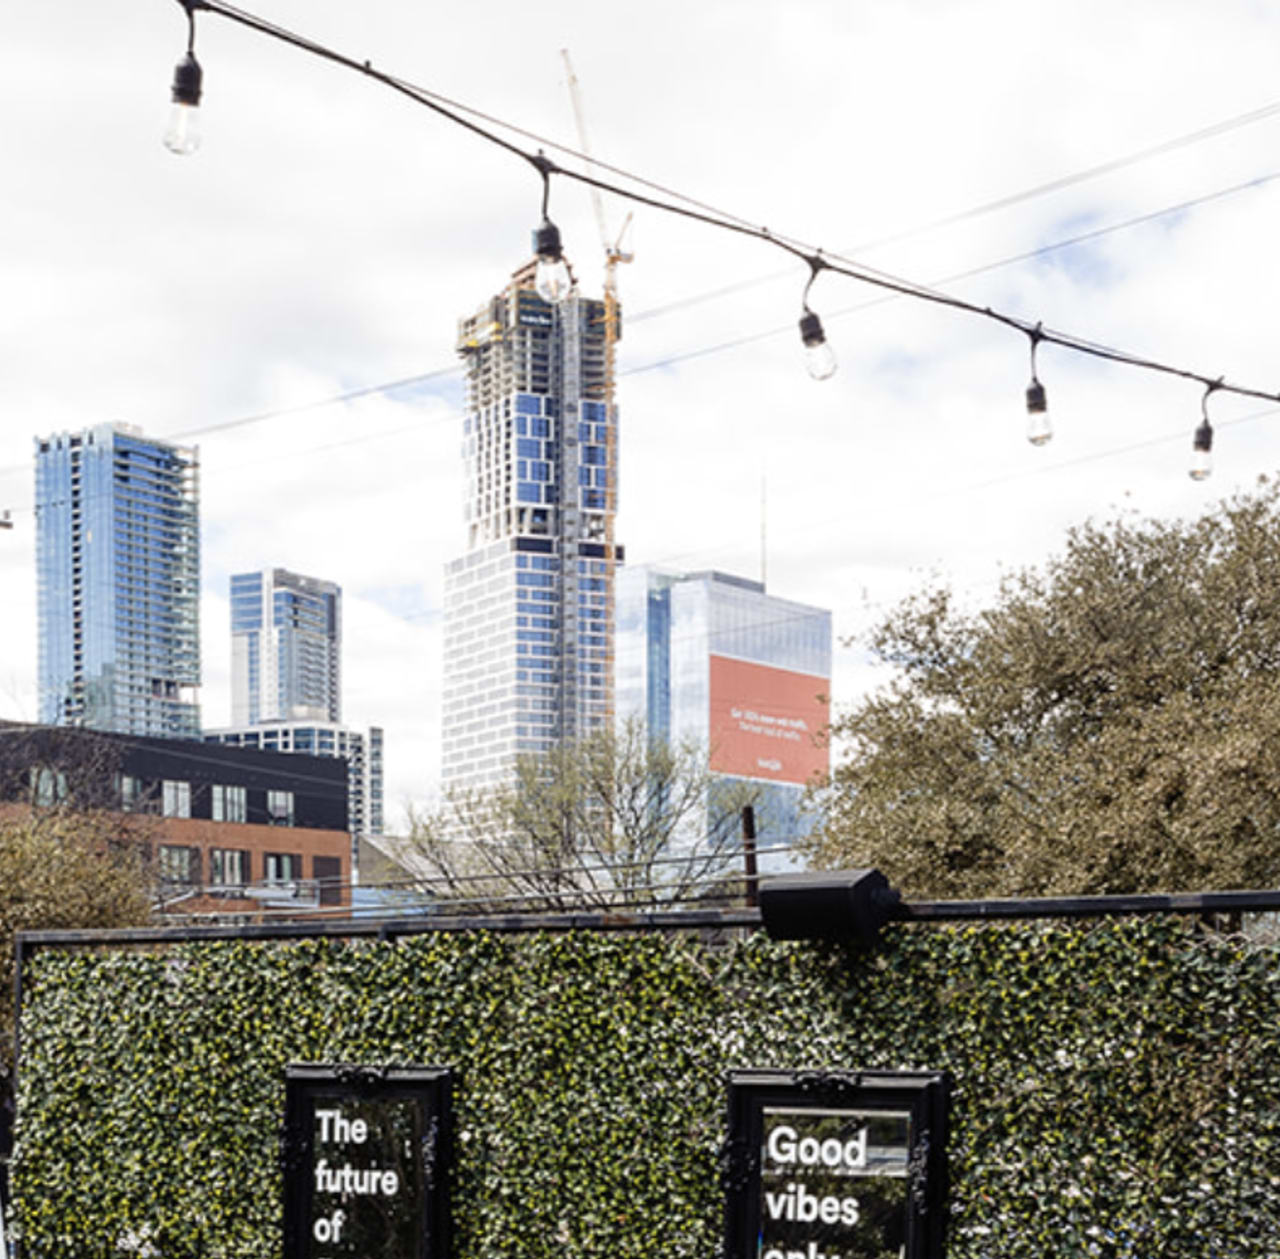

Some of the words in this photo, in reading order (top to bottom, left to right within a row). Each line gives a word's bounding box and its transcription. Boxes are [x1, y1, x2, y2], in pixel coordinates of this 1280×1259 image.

[315, 1110, 368, 1144] The
[767, 1126, 867, 1167] Good
[315, 1160, 399, 1195] future
[765, 1184, 860, 1225] vibes
[313, 1210, 345, 1242] of
